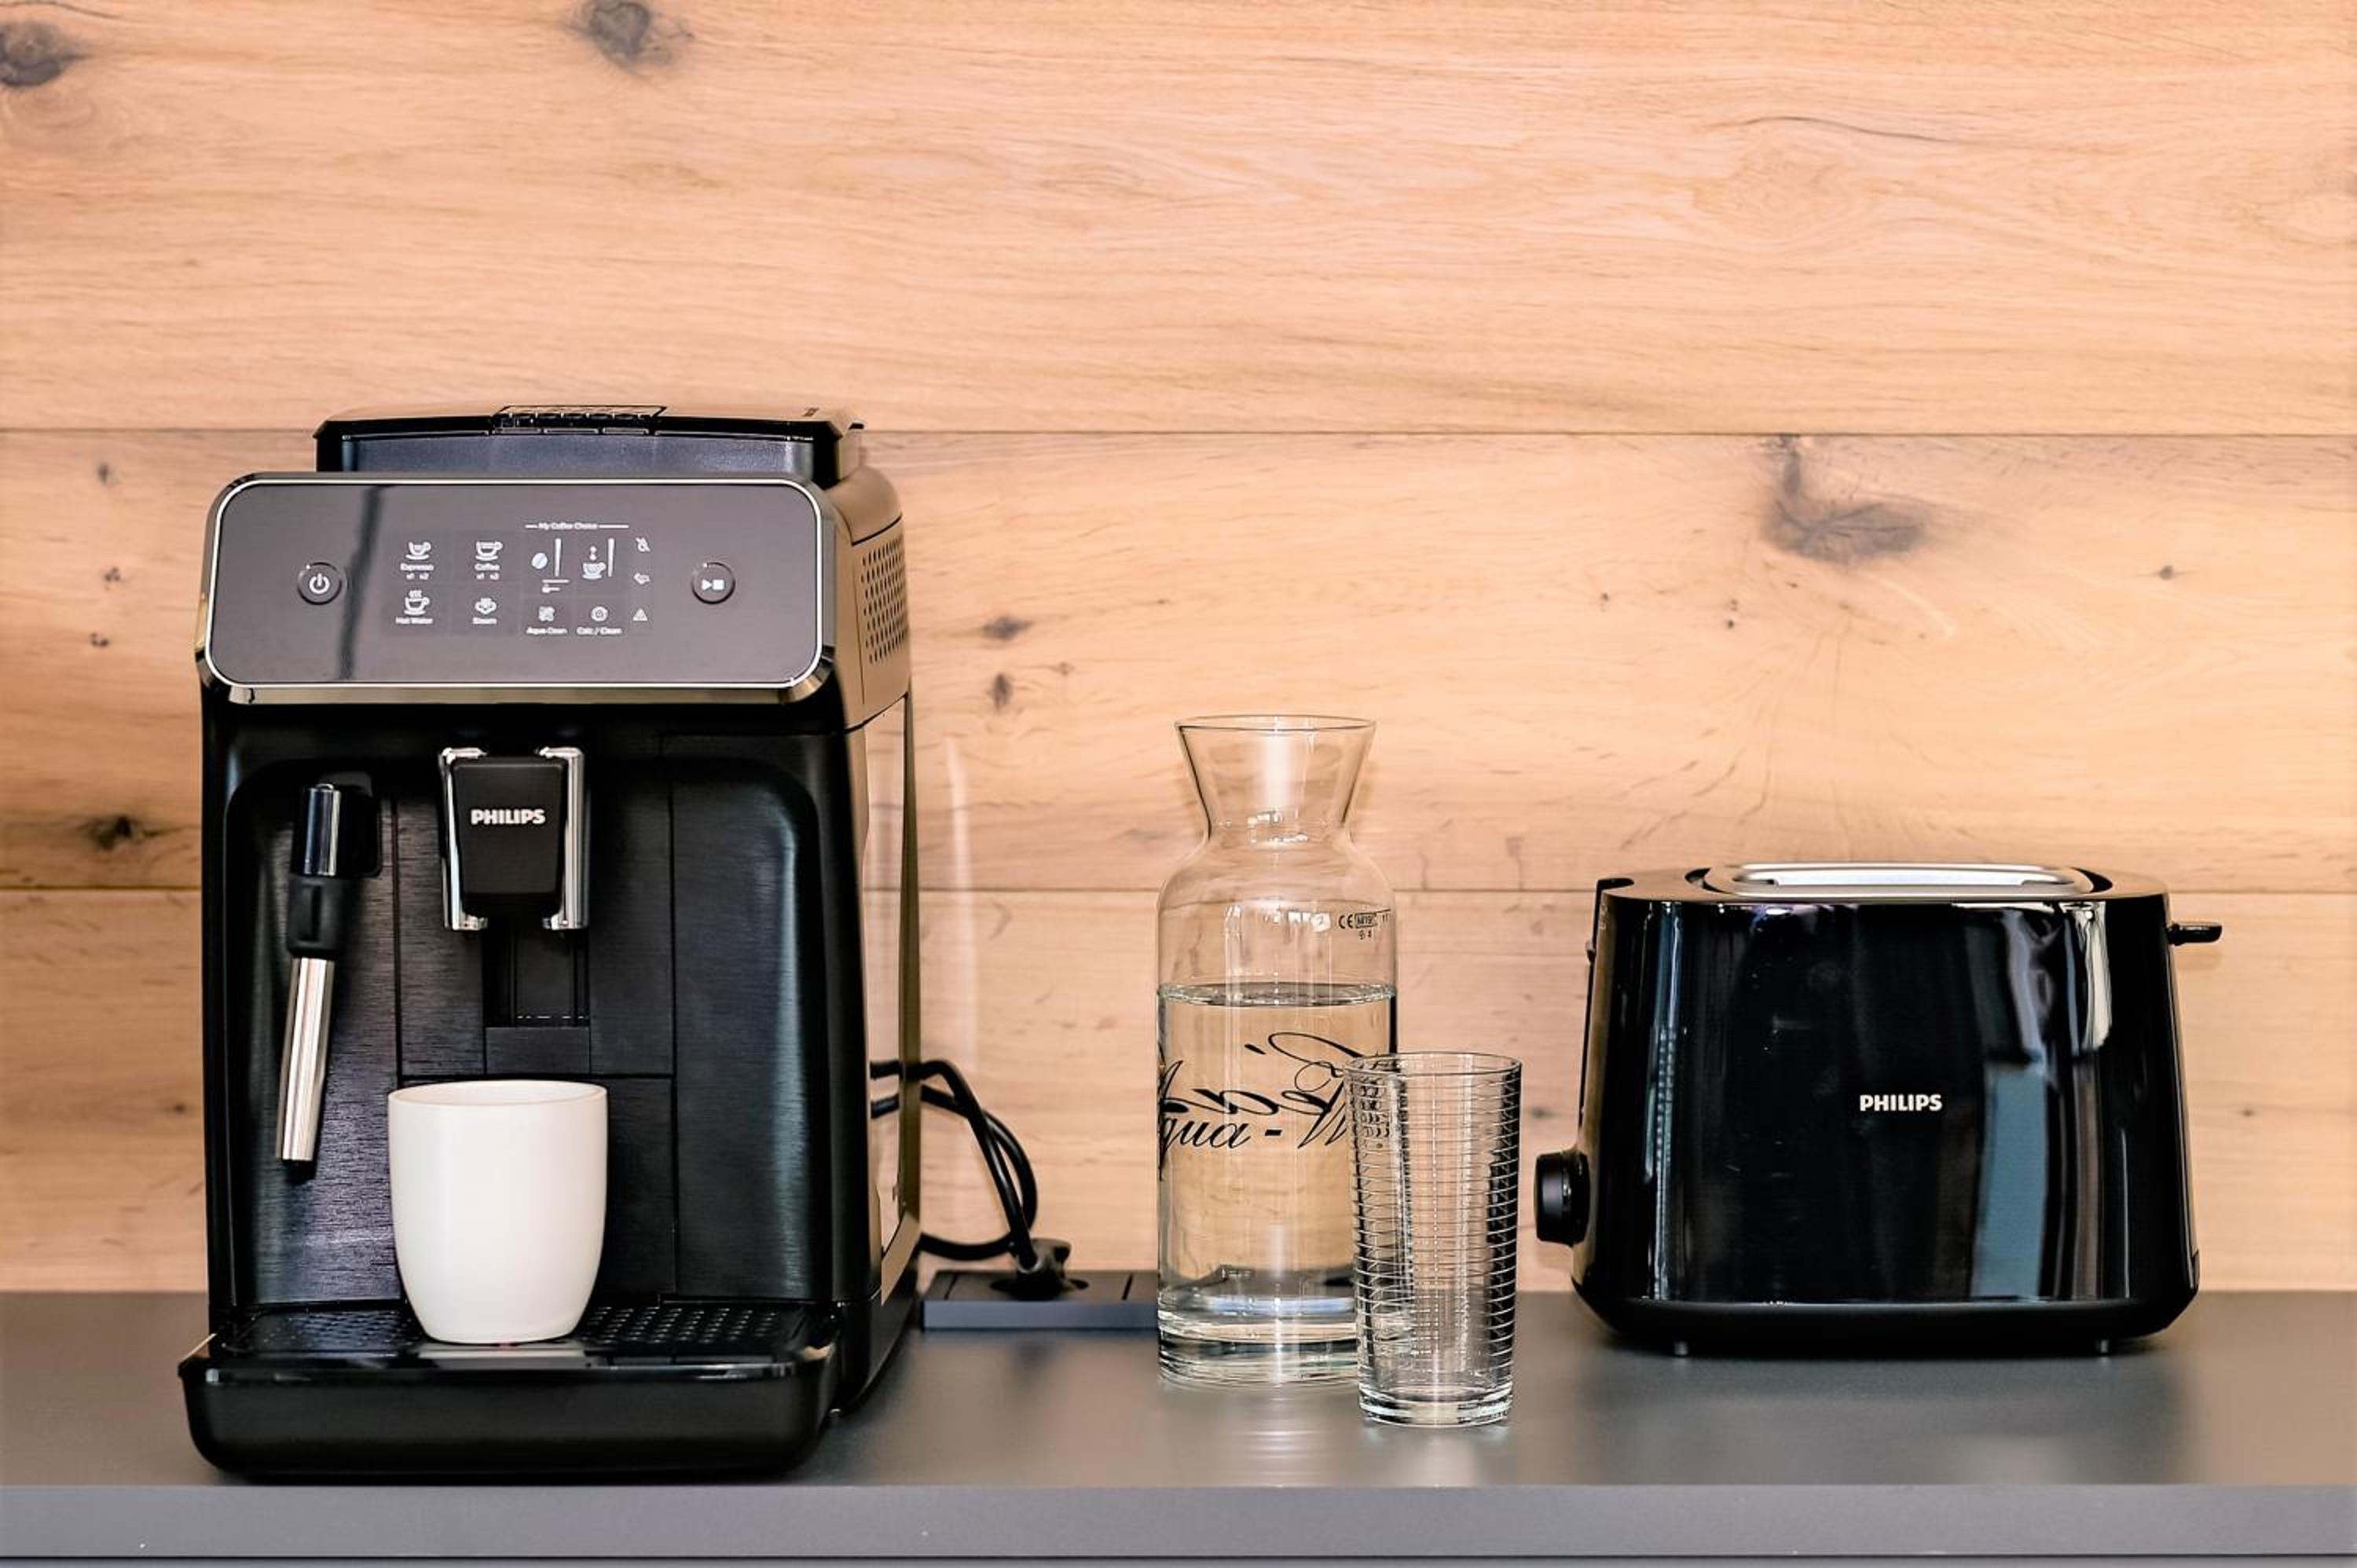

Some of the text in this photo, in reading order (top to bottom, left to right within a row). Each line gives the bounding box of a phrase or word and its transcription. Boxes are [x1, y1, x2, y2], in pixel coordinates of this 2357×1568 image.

[474, 562, 500, 571] Coffee
[471, 808, 546, 825] PHILIPS
[1860, 1094, 1943, 1112] PHILIPS
